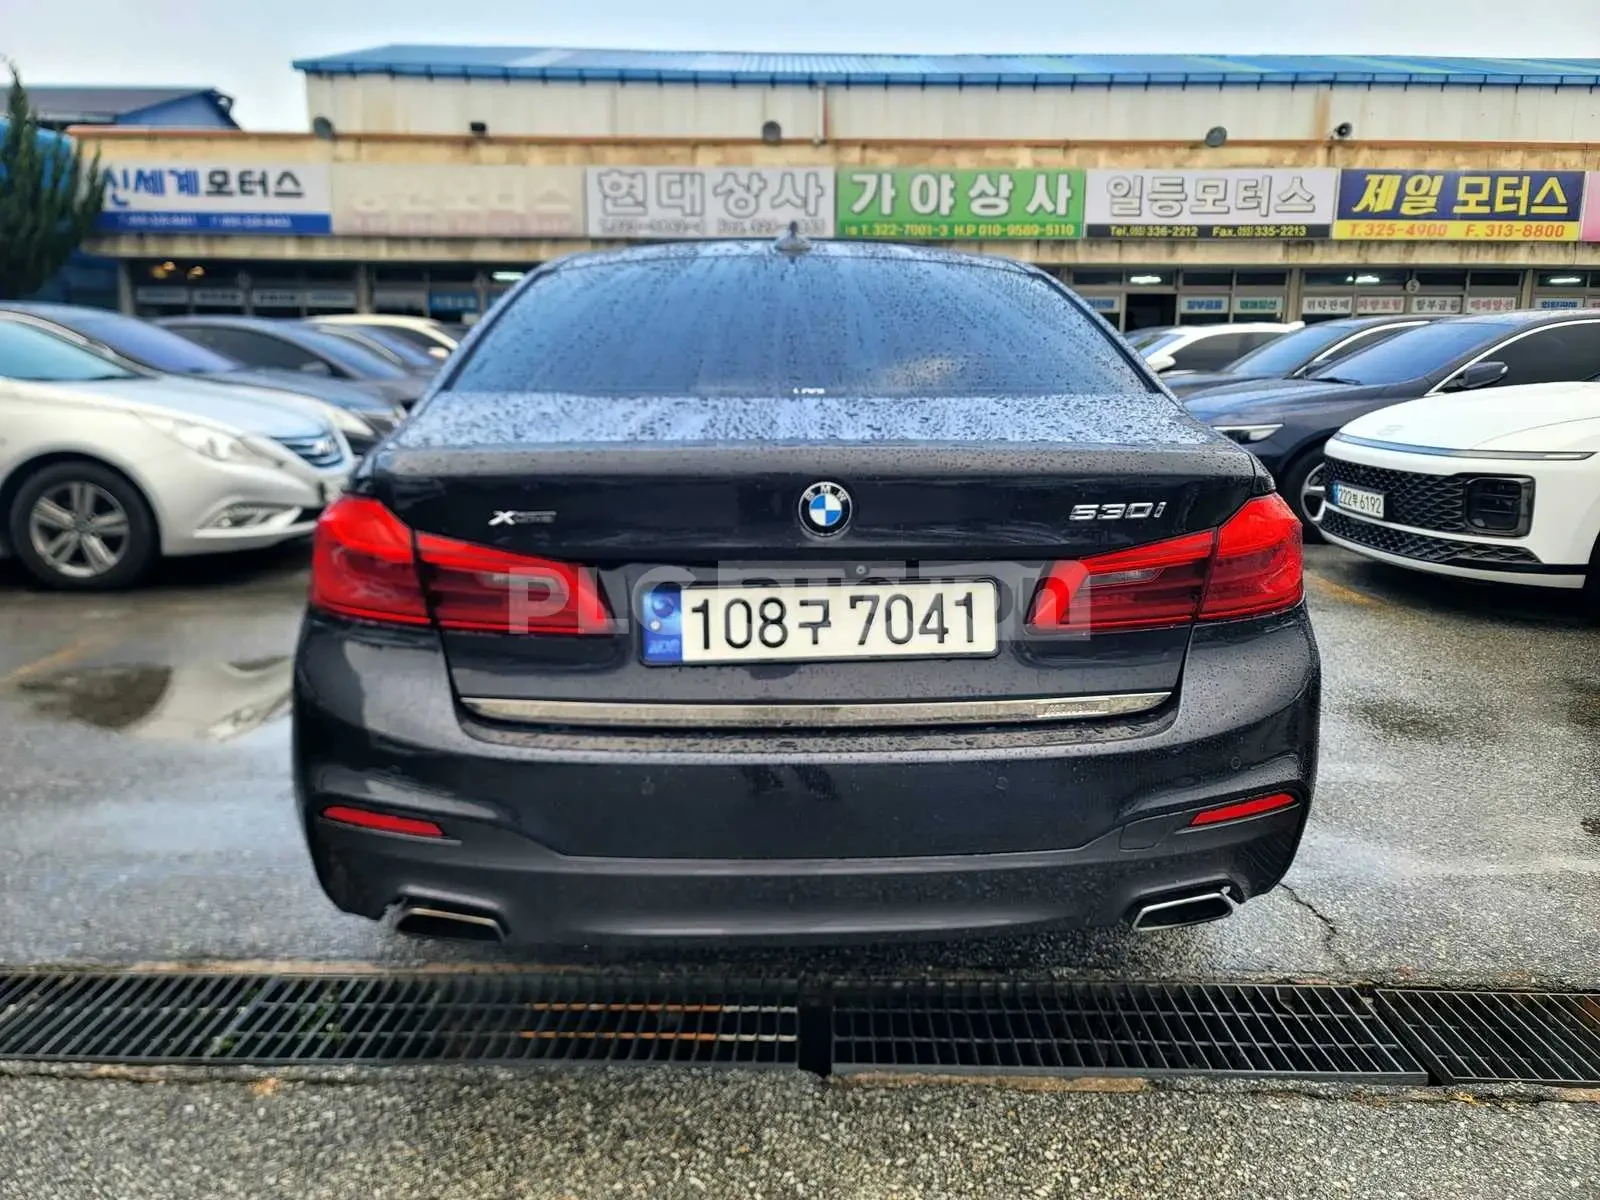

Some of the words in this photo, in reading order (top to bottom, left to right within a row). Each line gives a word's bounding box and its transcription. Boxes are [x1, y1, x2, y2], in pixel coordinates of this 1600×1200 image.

[597, 168, 826, 218] 현대상사
[851, 172, 1073, 216] 가야상사
[1106, 175, 1316, 217] 일등모터스
[1352, 174, 1444, 216] 제일
[1453, 175, 1569, 216] 모터스
[691, 597, 832, 651] 108구
[849, 591, 975, 647] 7041
